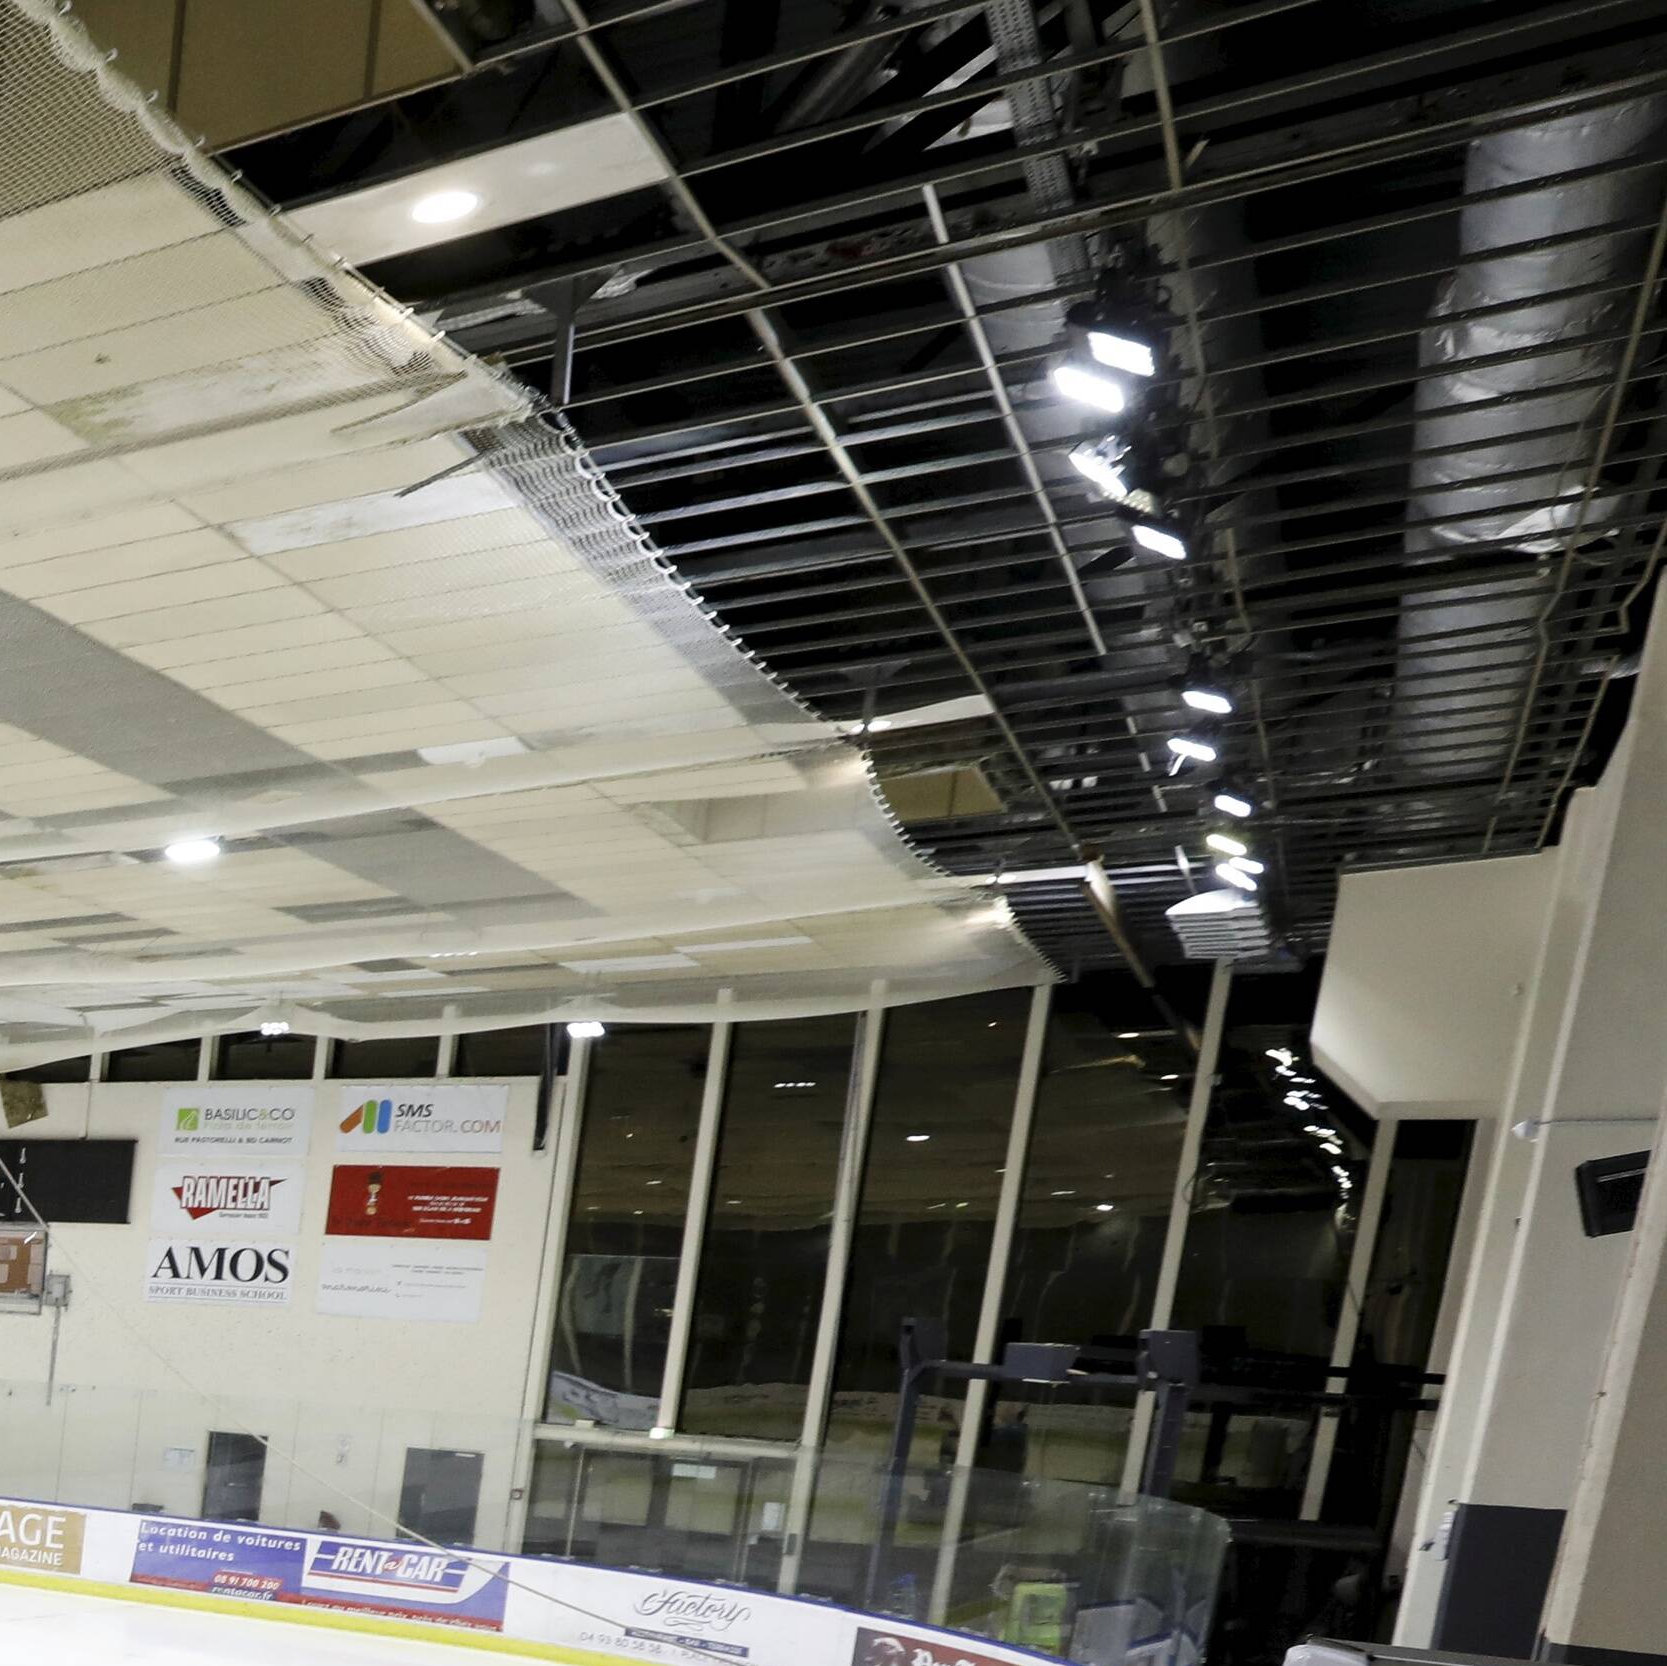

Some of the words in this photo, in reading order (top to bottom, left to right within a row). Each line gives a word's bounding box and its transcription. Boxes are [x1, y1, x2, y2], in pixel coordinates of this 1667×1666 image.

[395, 1103, 433, 1118] SMS
[180, 1175, 272, 1210] RAMELLA
[150, 1245, 290, 1284] AMOS
[149, 1285, 183, 1296] SPORT
[186, 1286, 238, 1298] BUSINESS
[240, 1289, 286, 1300] SCHOOL
[140, 1521, 207, 1540] Location
[213, 1530, 232, 1543] de
[237, 1535, 302, 1551] voitures
[138, 1542, 155, 1552] et
[159, 1544, 235, 1562] utilitaires
[331, 1546, 394, 1575] RENT
[396, 1553, 449, 1583] CAR
[214, 1574, 227, 1584] 08
[228, 1575, 239, 1585] 91
[240, 1576, 260, 1587] 700
[633, 1589, 751, 1631] Factory
